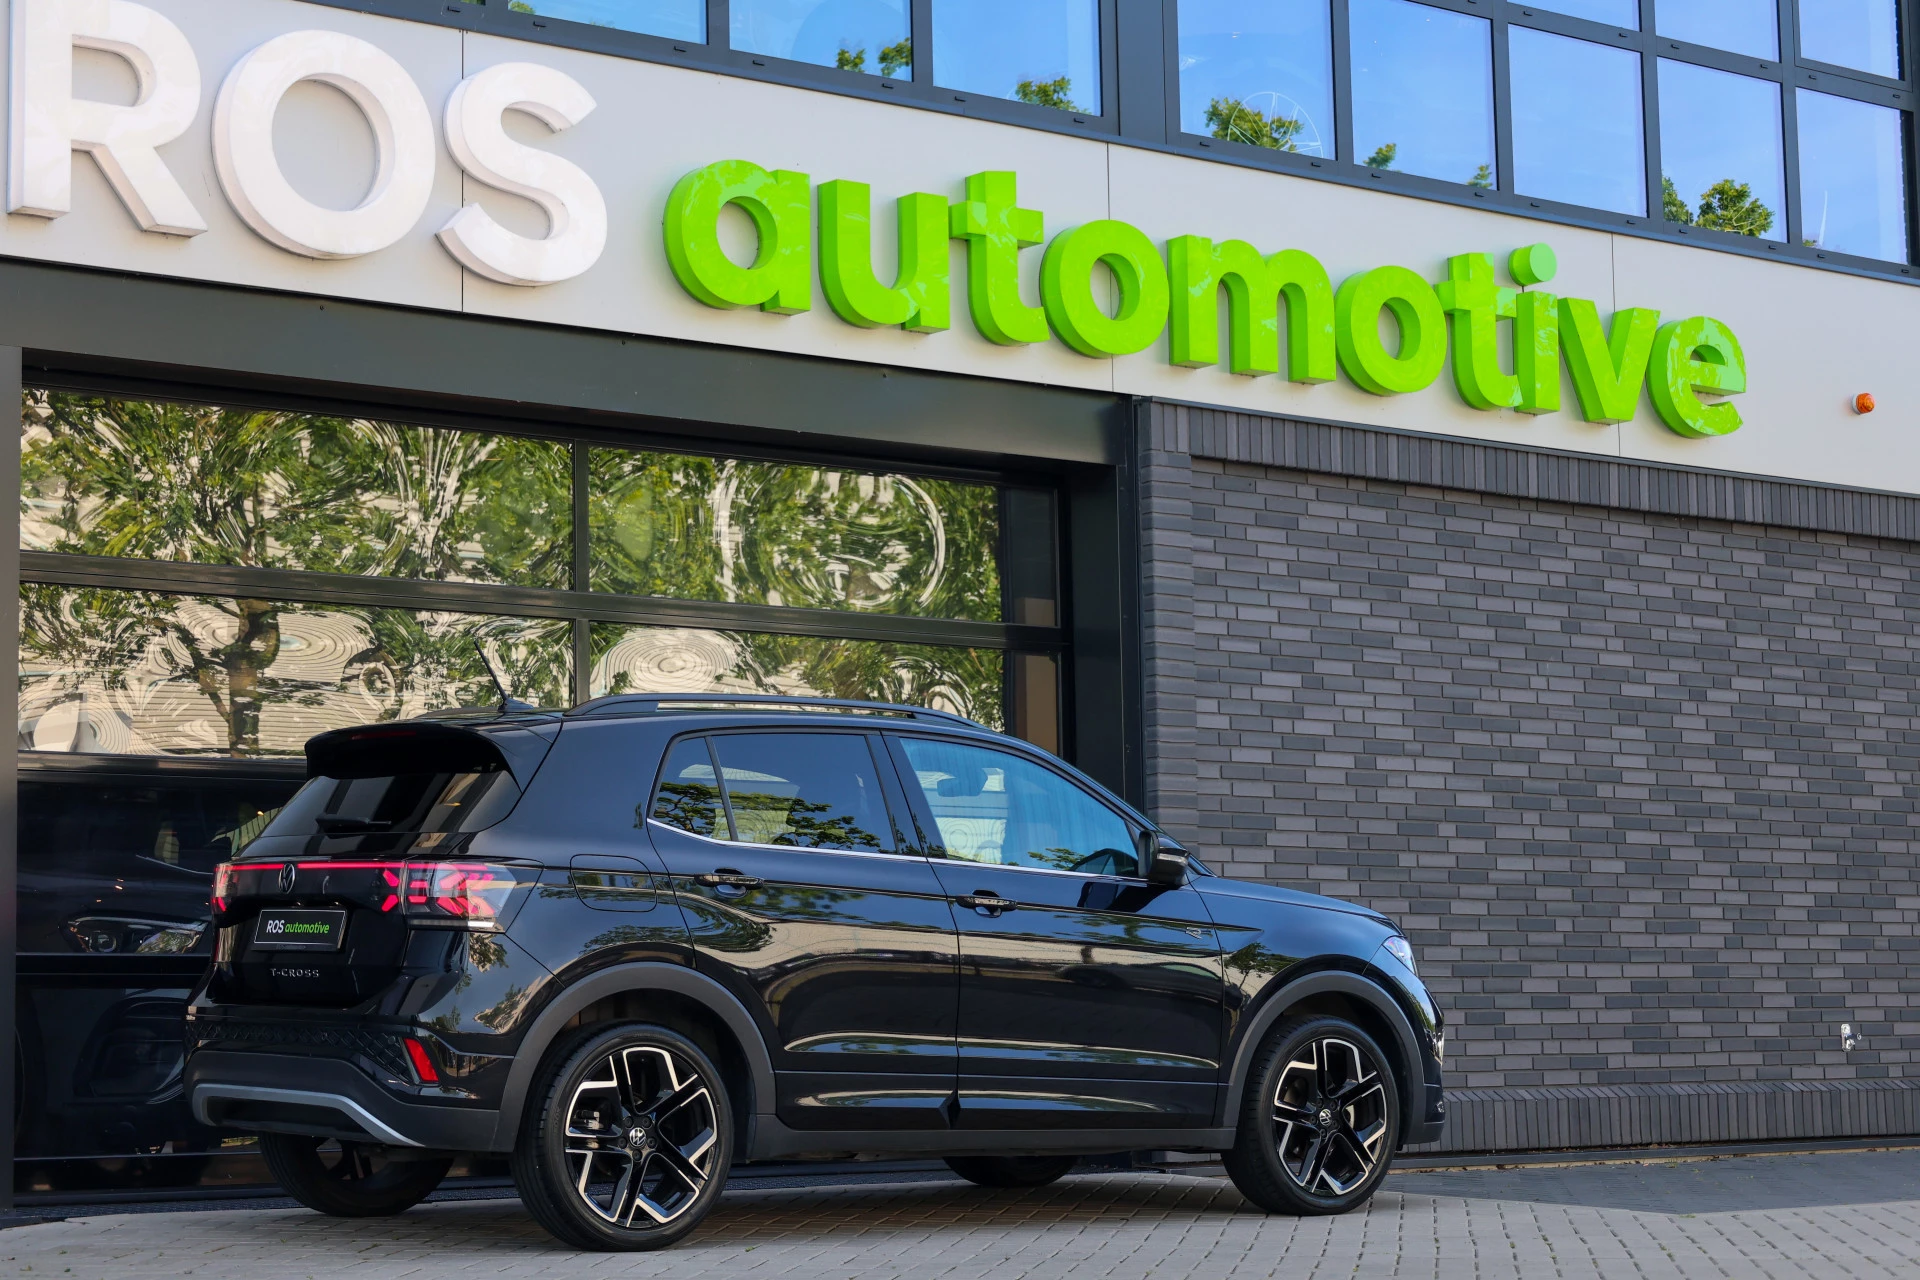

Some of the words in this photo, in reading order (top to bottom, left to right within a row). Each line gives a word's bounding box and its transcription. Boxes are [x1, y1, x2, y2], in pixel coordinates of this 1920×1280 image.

[8, 0, 607, 287] ROS
[663, 159, 1746, 439] automotive
[266, 920, 285, 933] ROS
[285, 921, 330, 934] automotive
[271, 968, 319, 978] T-CROSS
